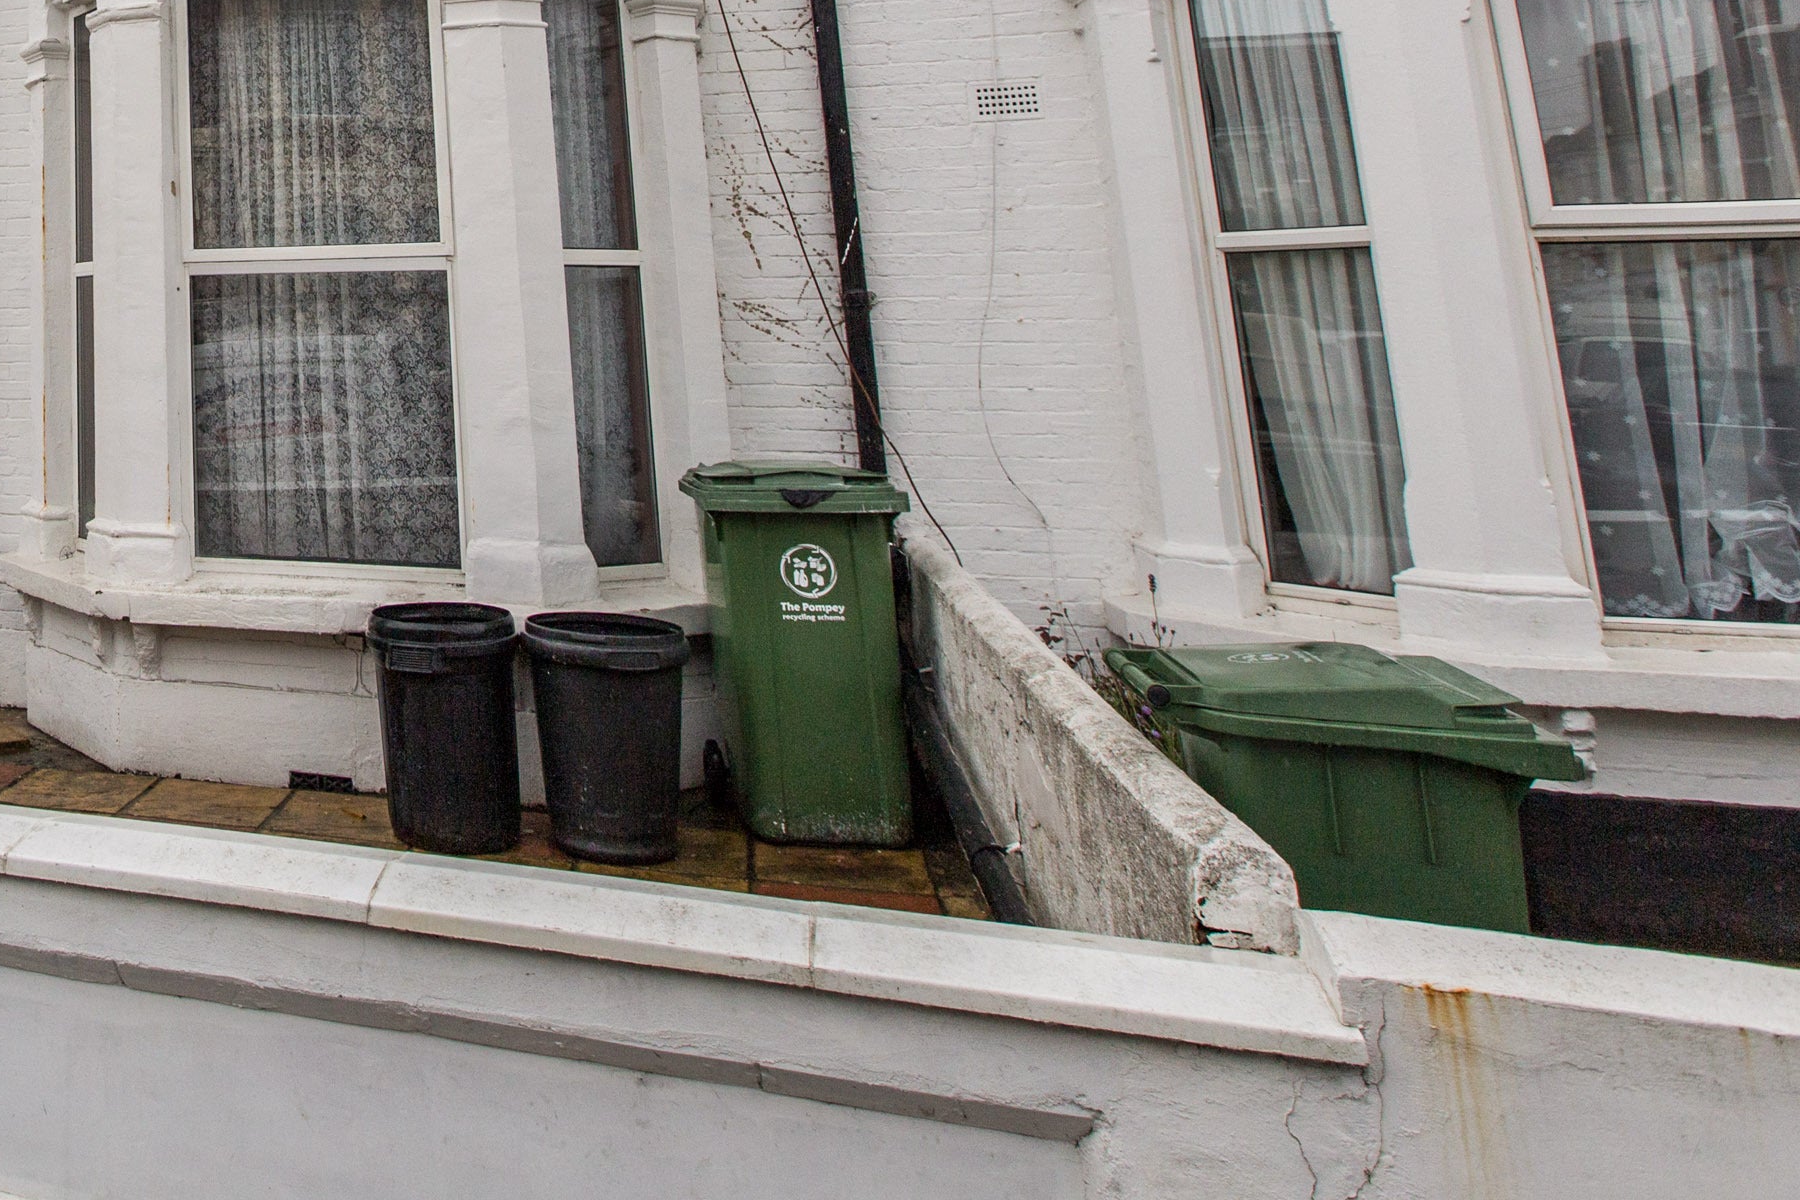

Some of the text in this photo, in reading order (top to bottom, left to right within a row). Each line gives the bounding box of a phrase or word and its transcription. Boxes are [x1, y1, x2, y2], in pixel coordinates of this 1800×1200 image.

[780, 602, 845, 614] The Pompey
[782, 613, 816, 622] recycling
